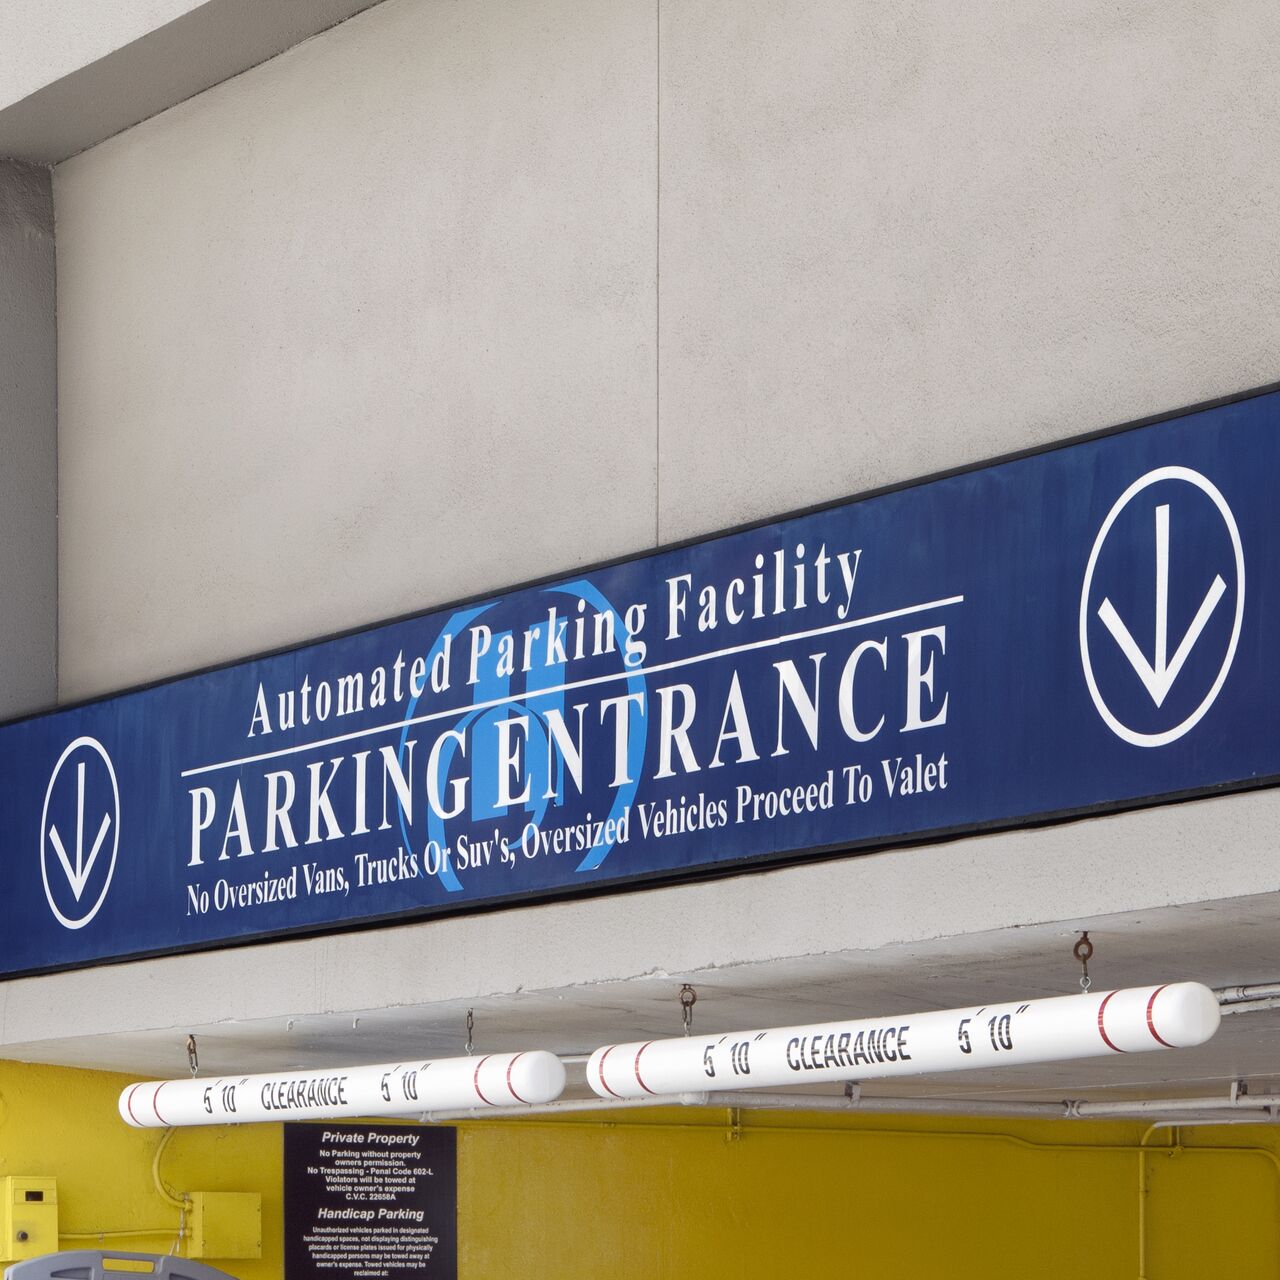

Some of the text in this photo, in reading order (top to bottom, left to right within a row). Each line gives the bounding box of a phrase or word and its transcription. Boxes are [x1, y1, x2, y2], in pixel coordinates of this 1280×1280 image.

[248, 543, 862, 738] Automated Parking Facility
[187, 625, 949, 867] PARKING ENTRANCE
[186, 752, 948, 916] No Oversized Vans, Trucks Or Suv's, Oversized Vehicles Proceed To Valet
[786, 1026, 911, 1071] CLEARANCE
[261, 1076, 348, 1110] CLEARANCE
[322, 1132, 419, 1145] Private Property
[318, 1208, 424, 1221] Handicap Parking
